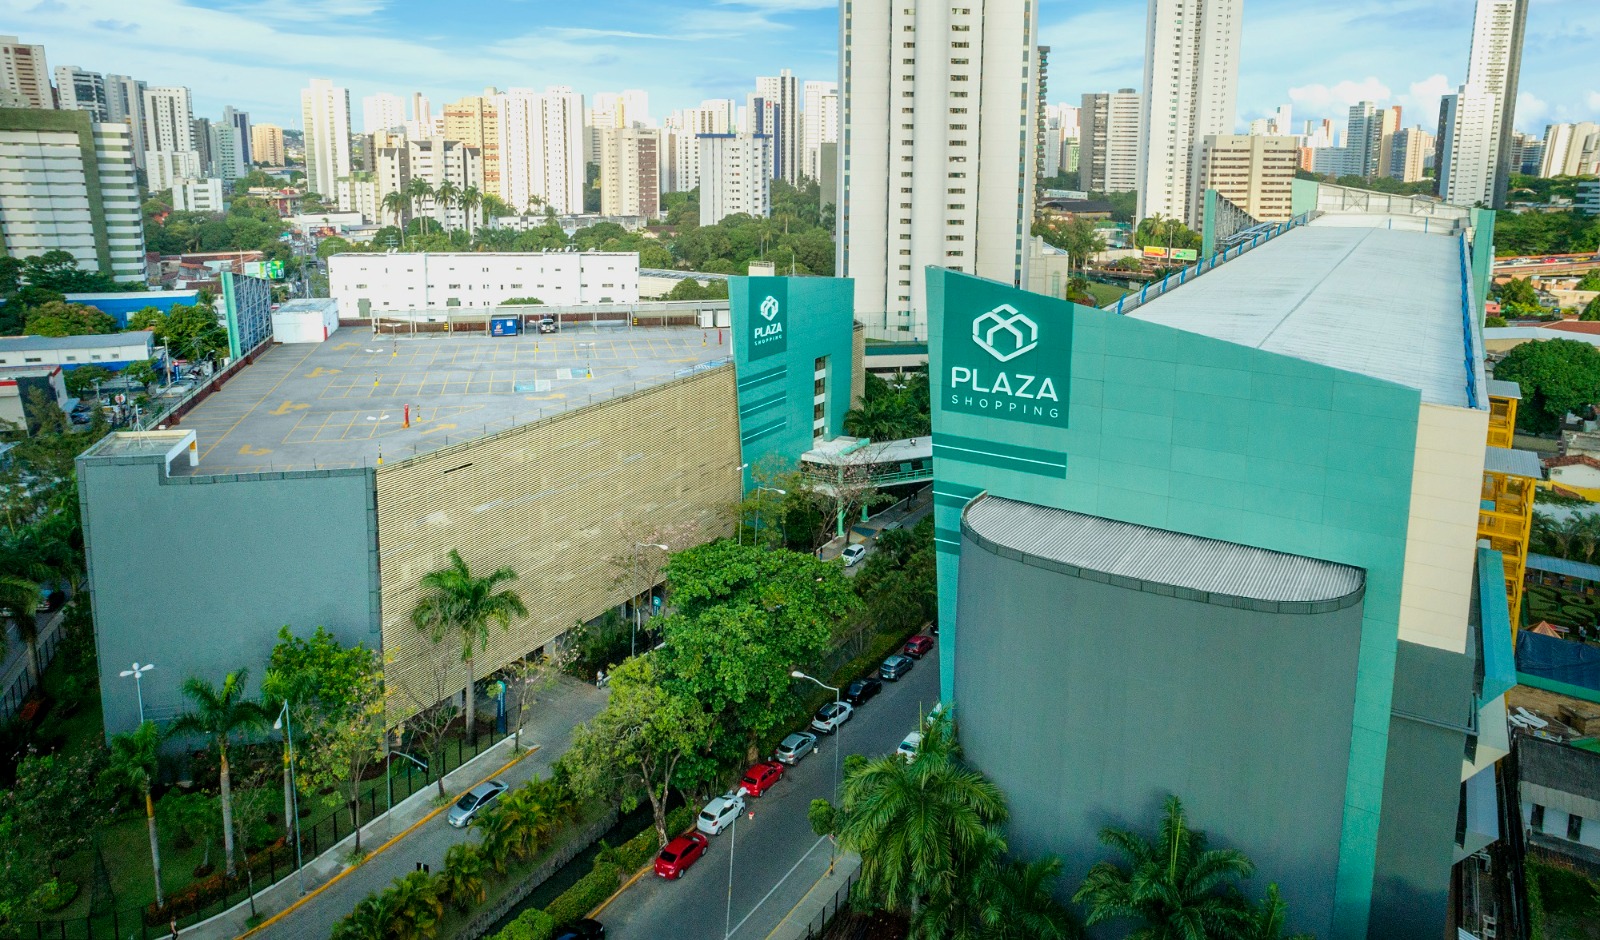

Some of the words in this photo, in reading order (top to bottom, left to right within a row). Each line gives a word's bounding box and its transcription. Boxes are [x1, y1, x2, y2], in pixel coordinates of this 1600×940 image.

[754, 322, 783, 339] PLAZA
[754, 334, 783, 346] SHOPPING
[951, 366, 1059, 402] PLAZA
[951, 394, 1059, 418] SHOPPING
